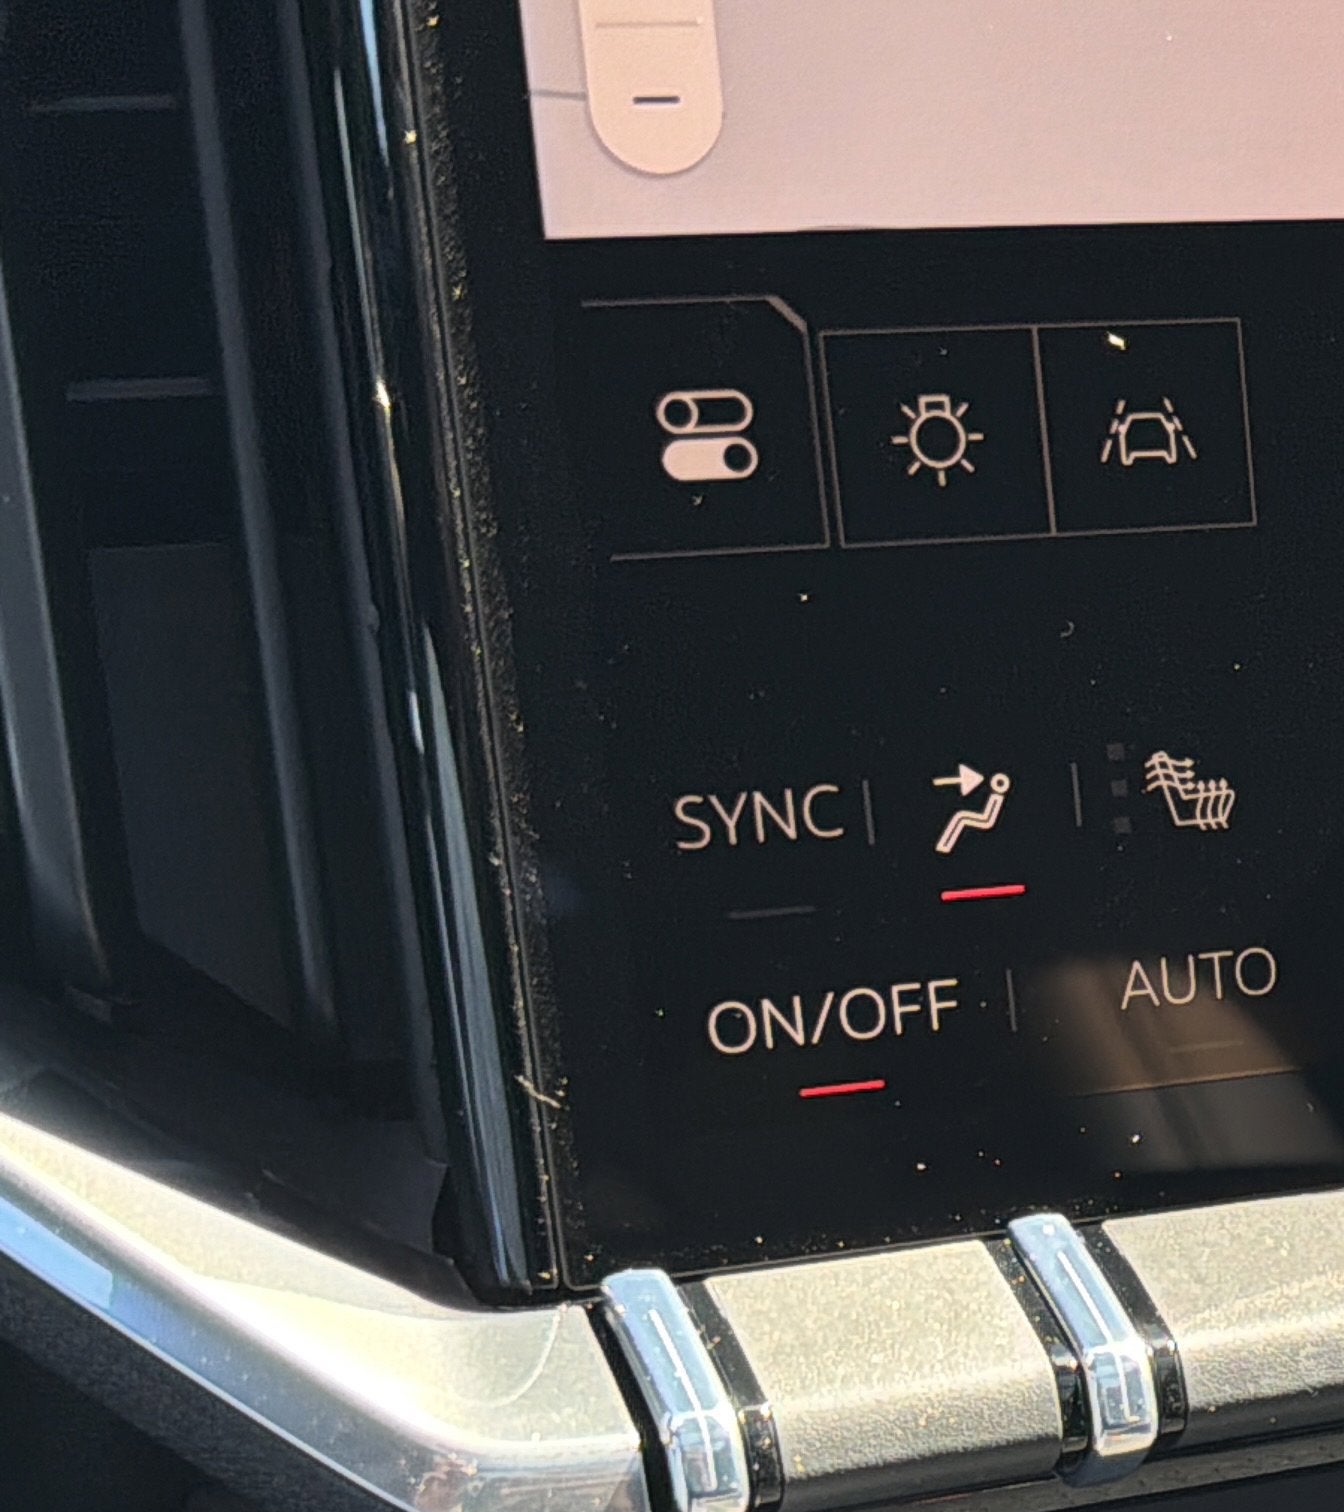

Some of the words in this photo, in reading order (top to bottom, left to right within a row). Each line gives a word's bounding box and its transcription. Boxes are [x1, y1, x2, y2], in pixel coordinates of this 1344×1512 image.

[674, 784, 845, 850] SYNC
[1121, 947, 1277, 1010] AUTO
[707, 978, 958, 1054] ON/OFF
